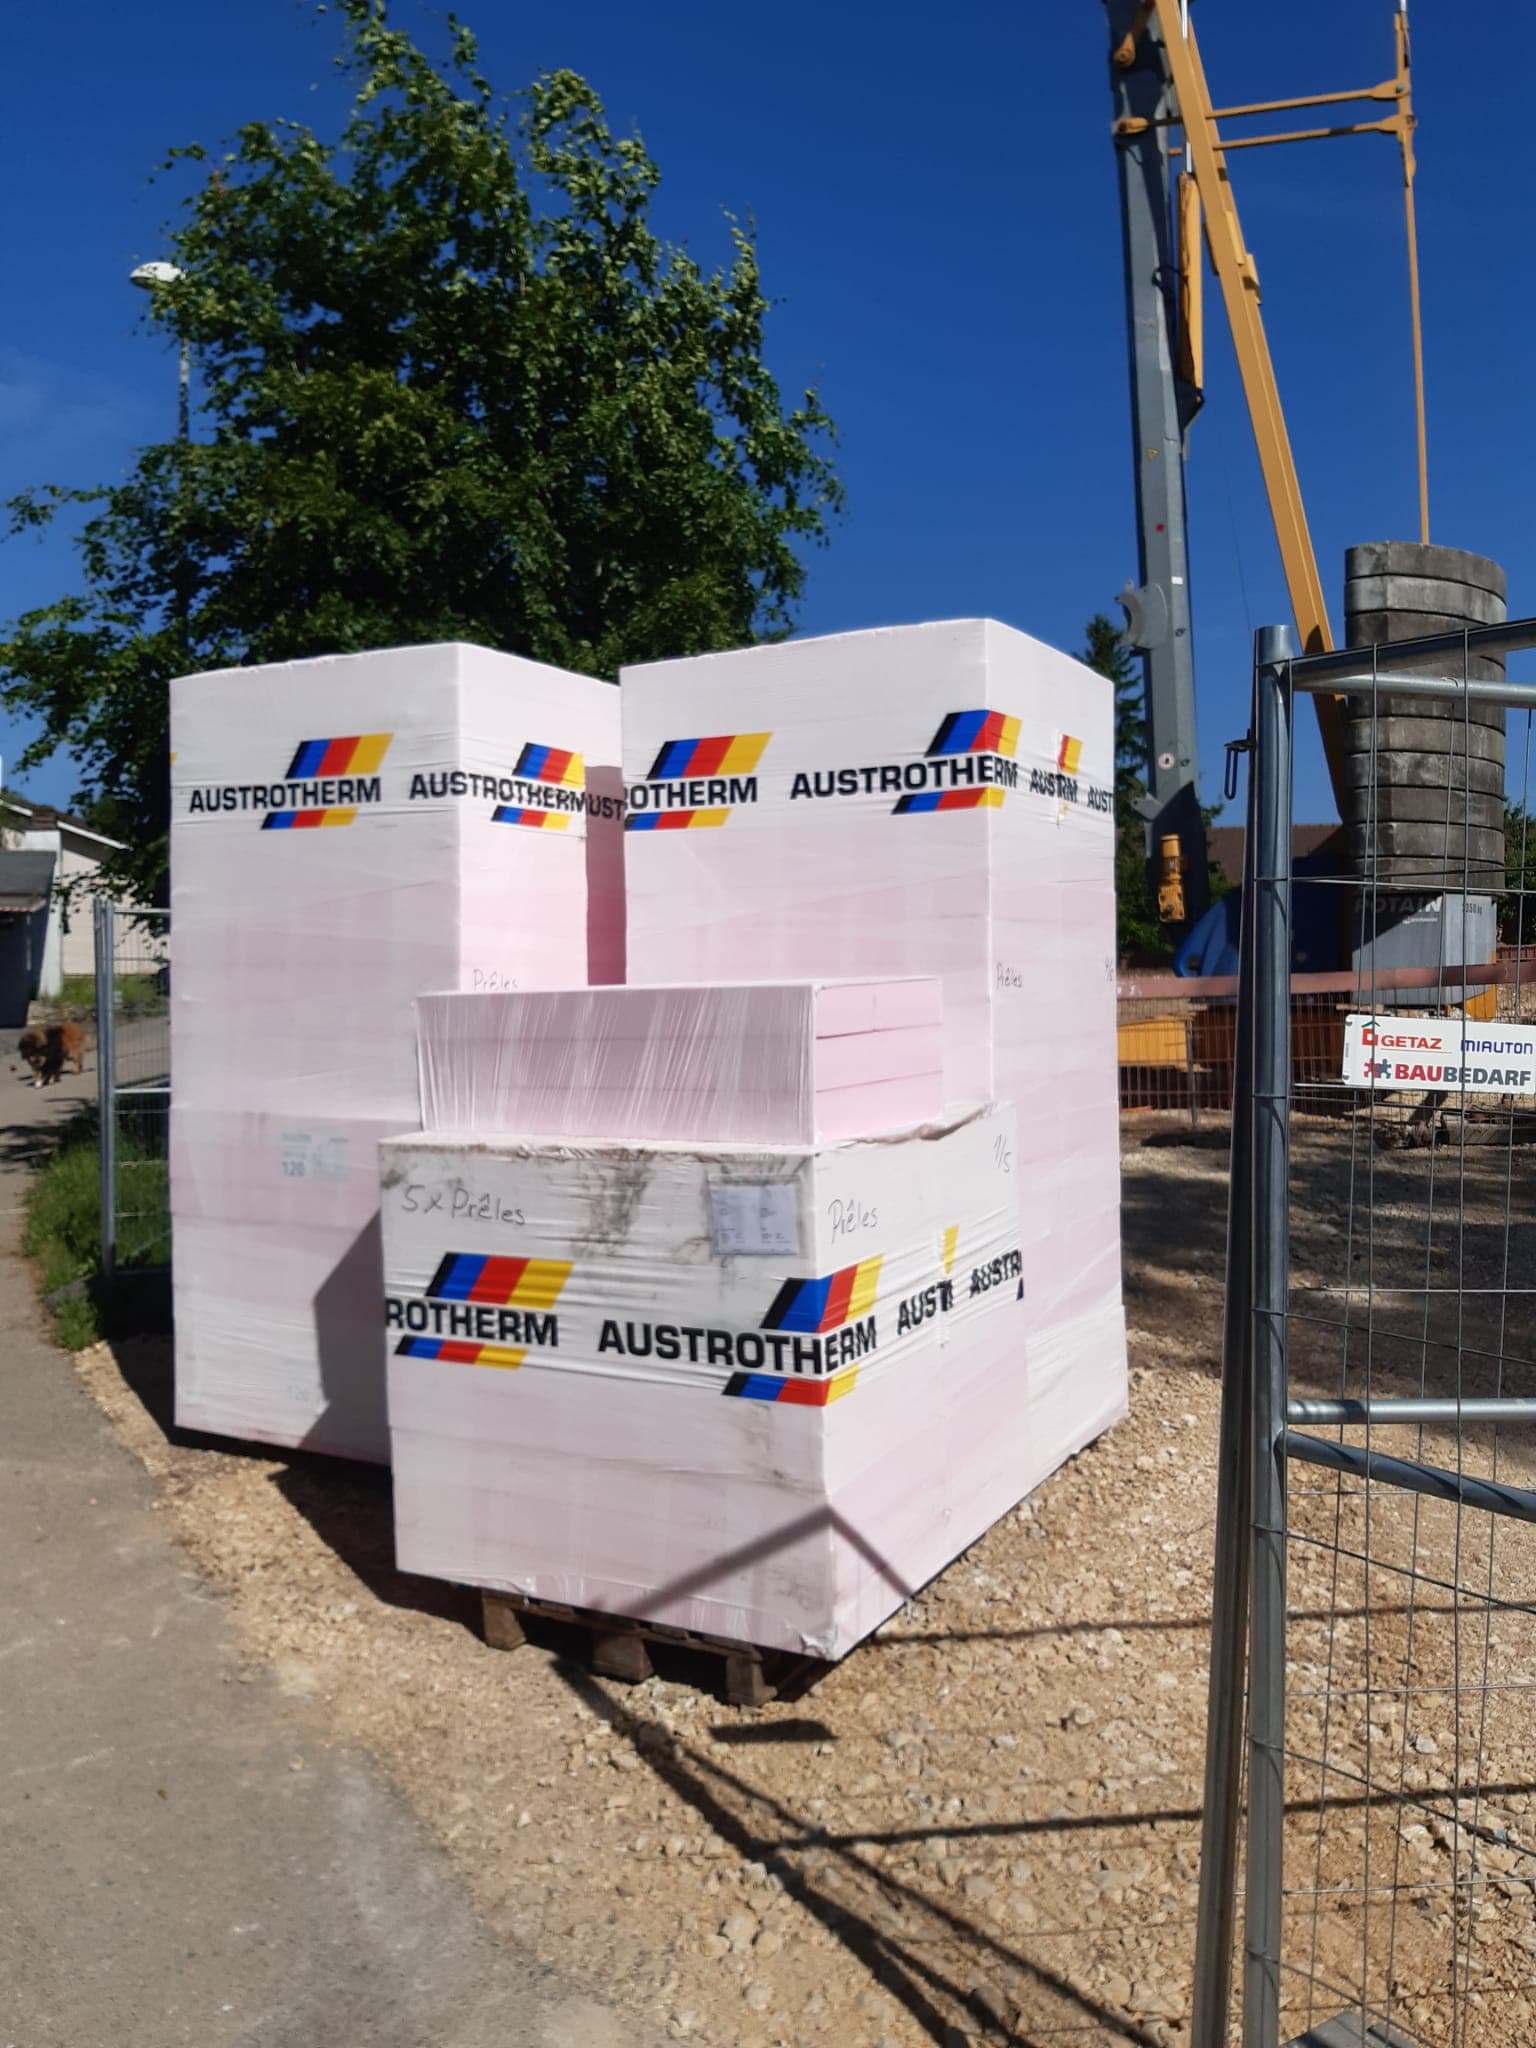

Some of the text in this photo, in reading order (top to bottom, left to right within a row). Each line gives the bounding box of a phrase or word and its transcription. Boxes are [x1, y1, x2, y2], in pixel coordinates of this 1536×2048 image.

[189, 772, 585, 813] AUSTROTHERM AUSTROTHERM
[624, 776, 758, 809] OTHERM
[790, 754, 1018, 800] AUSTROTHERM
[588, 794, 625, 821] UST
[1380, 1035, 1442, 1050] GETAZ
[1395, 1063, 1532, 1086] BAUBEDARF
[829, 1198, 879, 1244] Prêles
[385, 1298, 559, 1348] ROTHERM
[598, 1315, 877, 1375] AUSTROTHERM
